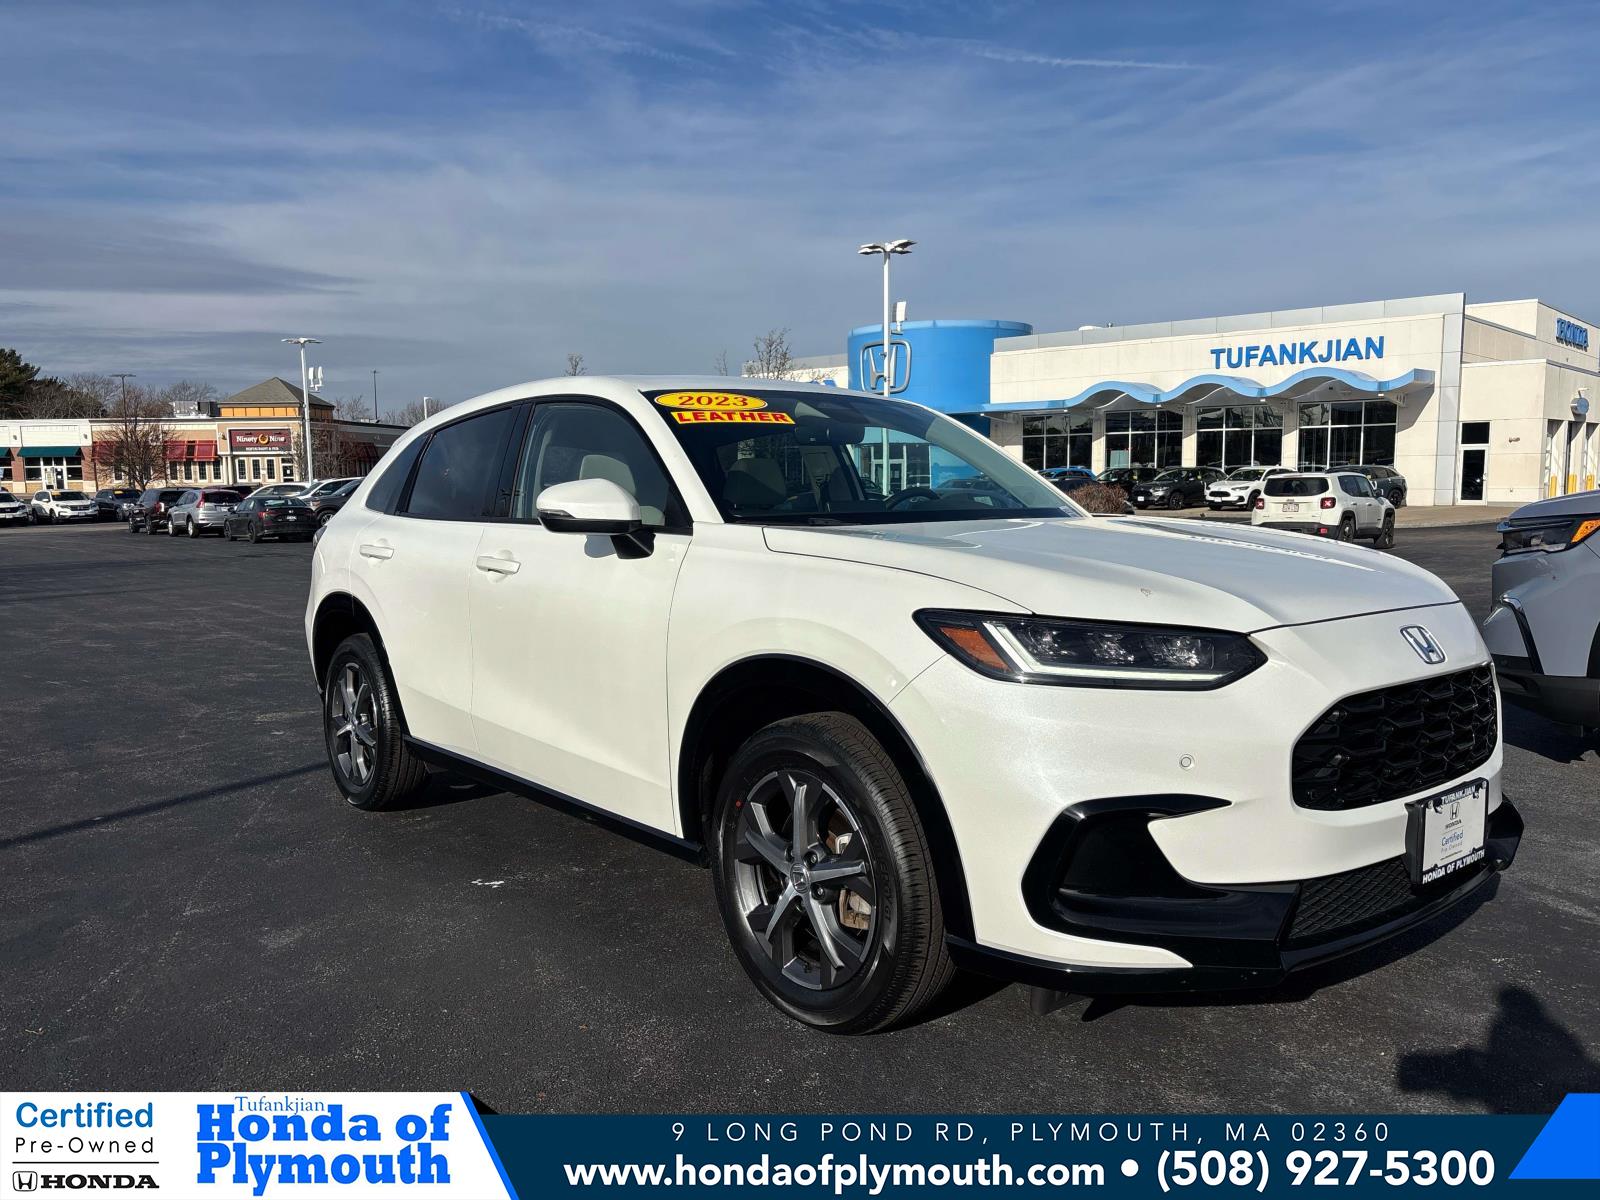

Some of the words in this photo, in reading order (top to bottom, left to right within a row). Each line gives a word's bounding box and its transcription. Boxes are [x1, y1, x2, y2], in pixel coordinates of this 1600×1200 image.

[1210, 335, 1385, 369] TUFANKJIAN
[678, 395, 749, 407] 2023
[676, 411, 789, 423] LEATHER
[236, 435, 257, 444] Ninety
[1422, 866, 1446, 885] HONDA
[1446, 862, 1456, 874] OF
[1455, 849, 1485, 870] PLYMOUTH
